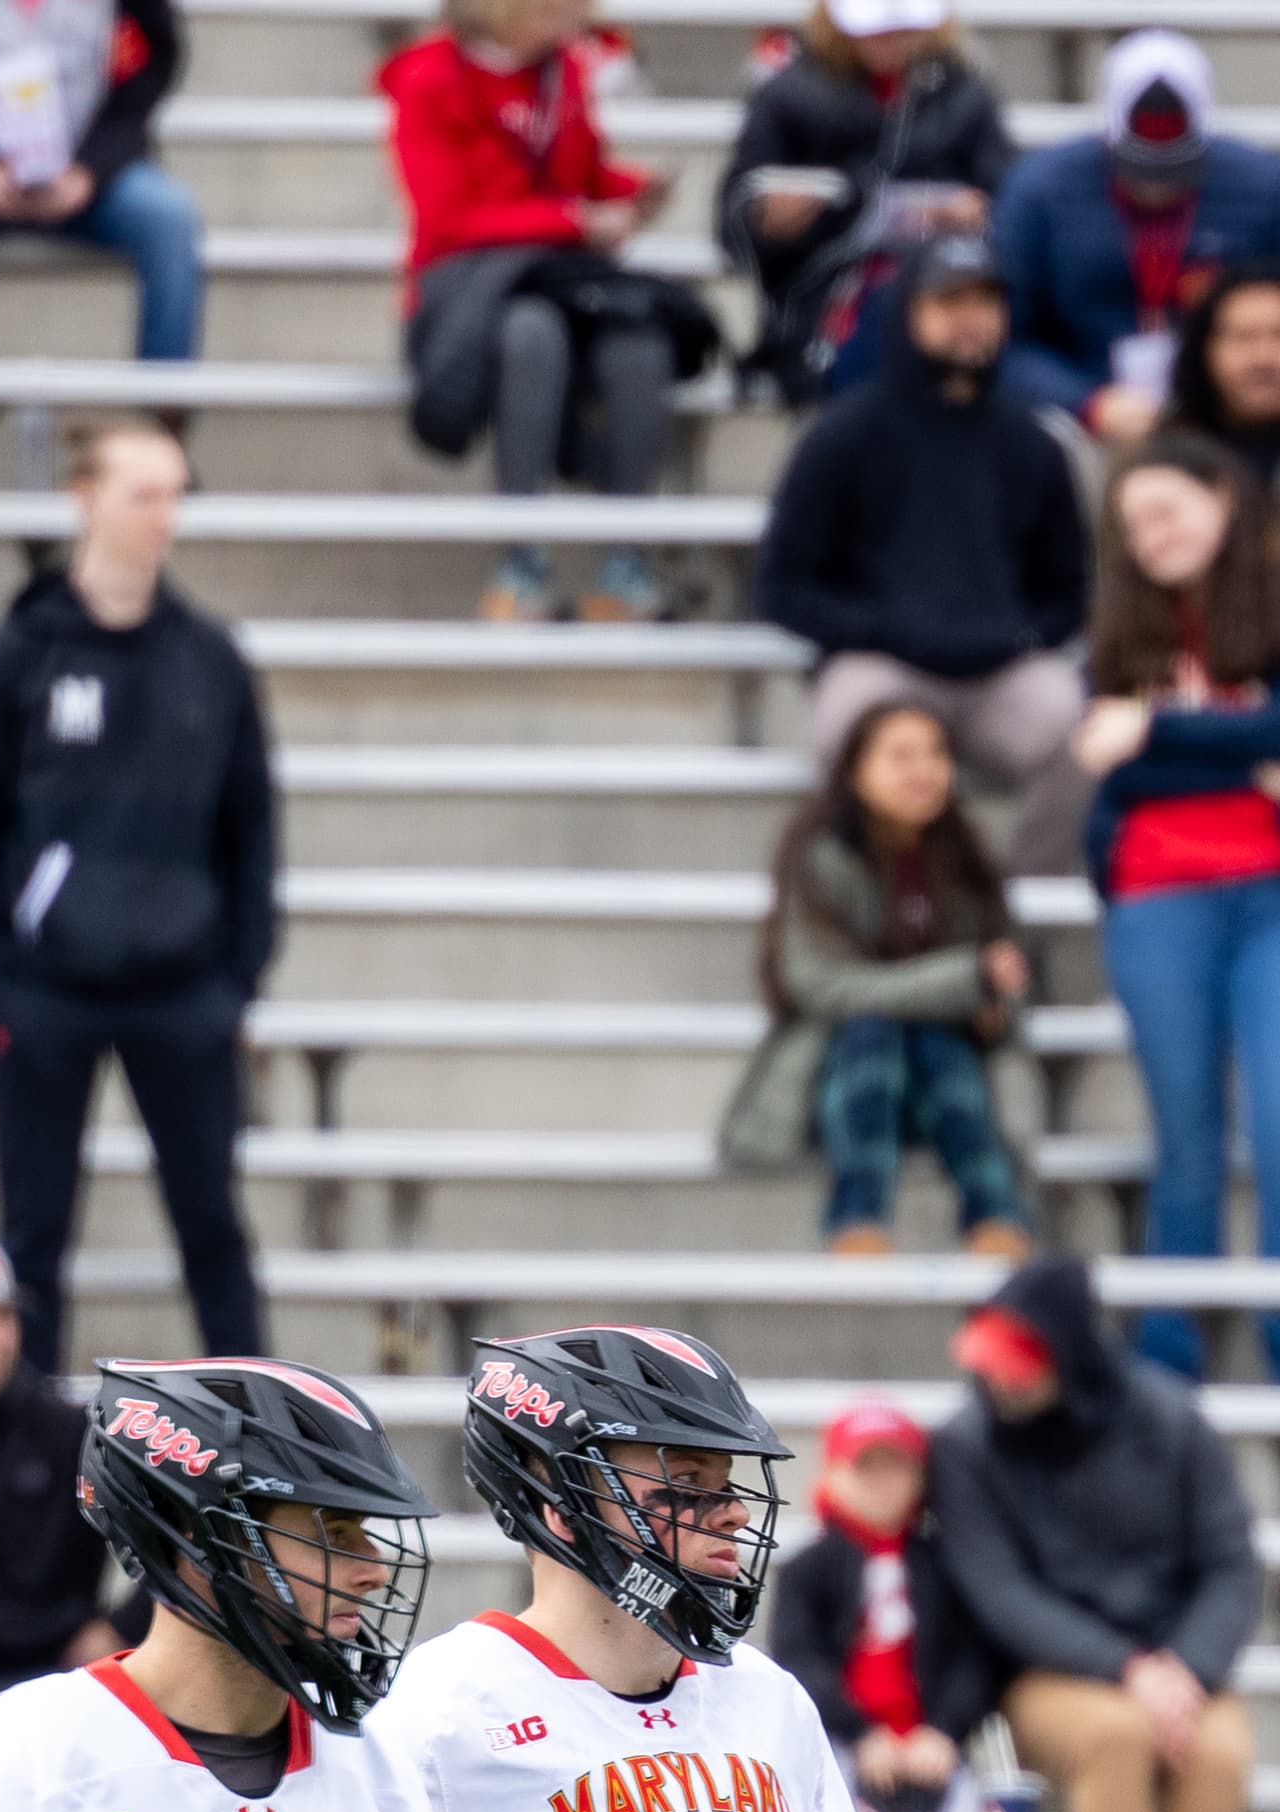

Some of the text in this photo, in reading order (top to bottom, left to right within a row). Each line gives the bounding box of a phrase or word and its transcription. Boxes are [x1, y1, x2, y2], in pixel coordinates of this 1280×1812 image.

[474, 1361, 565, 1427] Terps
[106, 1397, 218, 1476] Terps
[619, 1561, 678, 1610] PSALM
